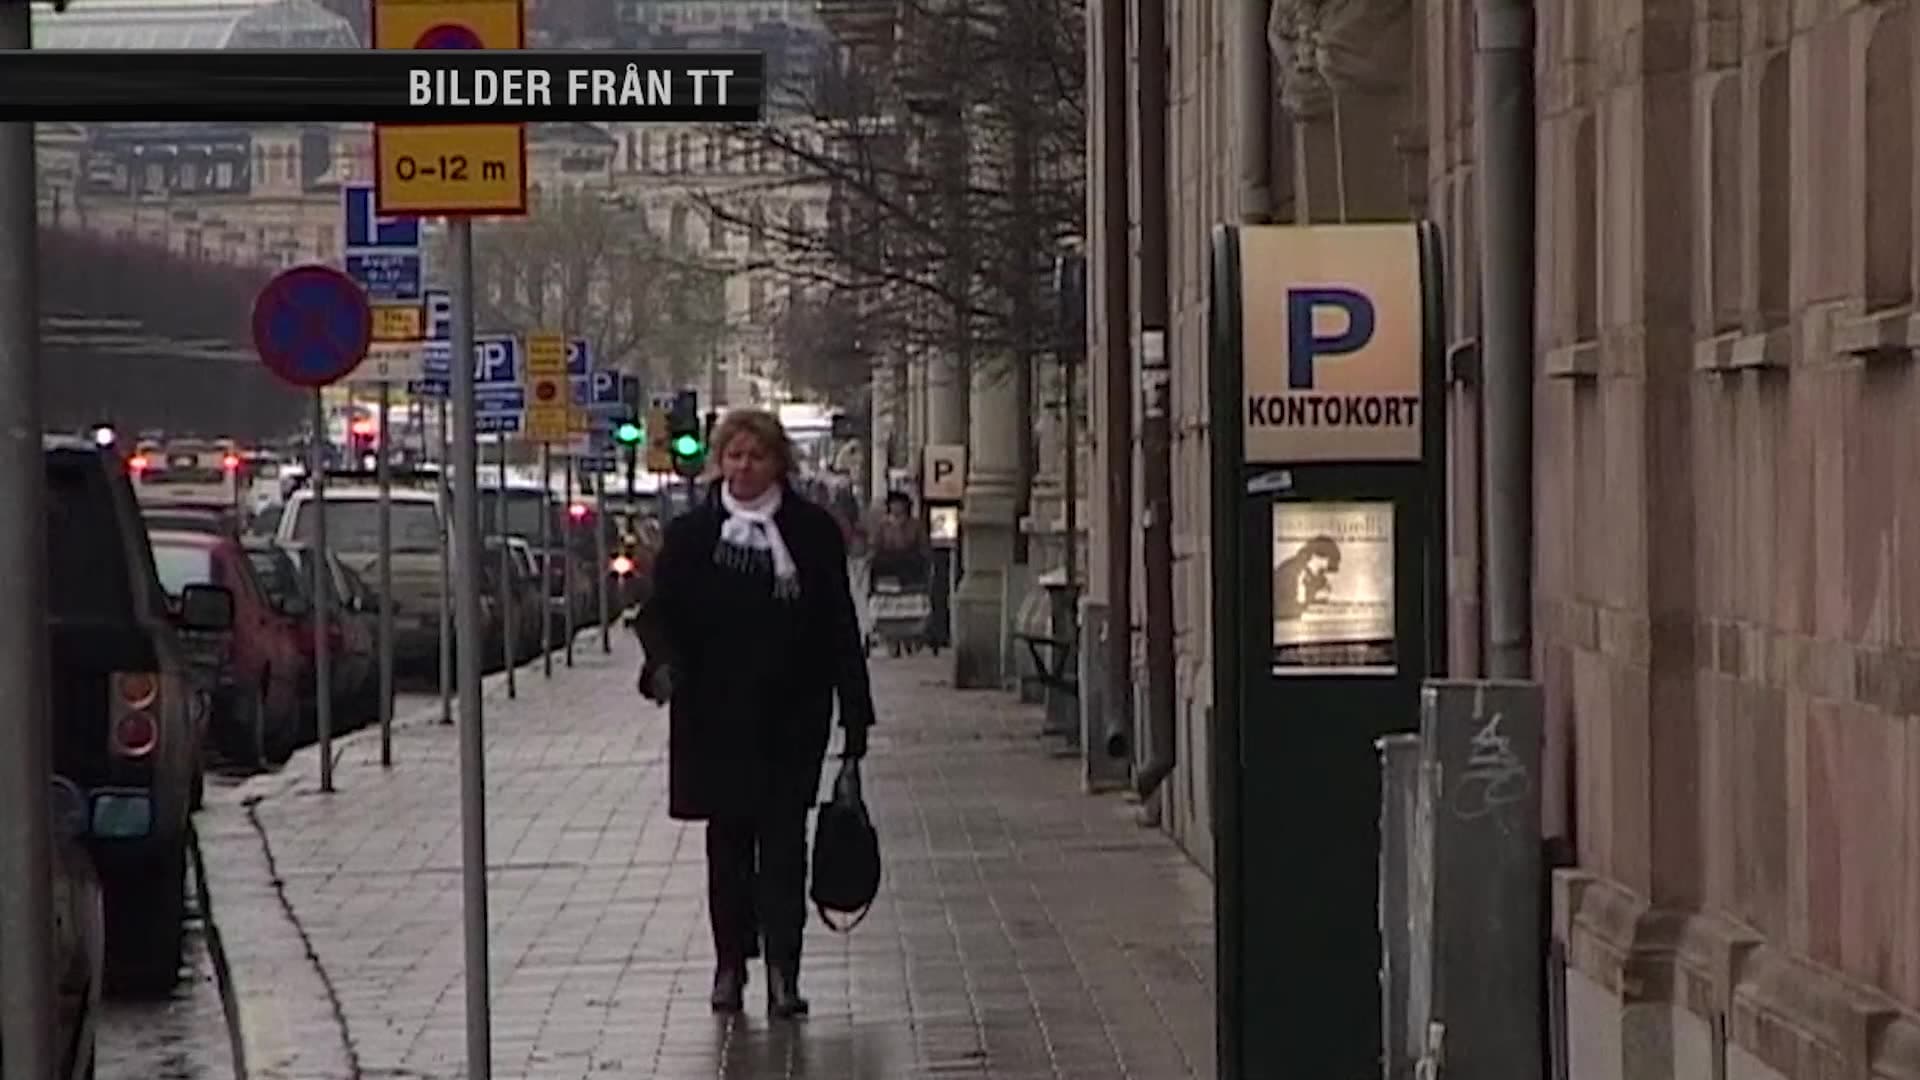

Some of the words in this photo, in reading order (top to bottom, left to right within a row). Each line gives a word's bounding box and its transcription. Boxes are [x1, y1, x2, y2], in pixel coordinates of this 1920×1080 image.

[482, 161, 506, 180] m
[1288, 288, 1375, 390] P
[484, 343, 506, 381] P
[593, 372, 612, 401] P
[1249, 396, 1419, 427] KONTOKORT
[935, 460, 954, 484] P
